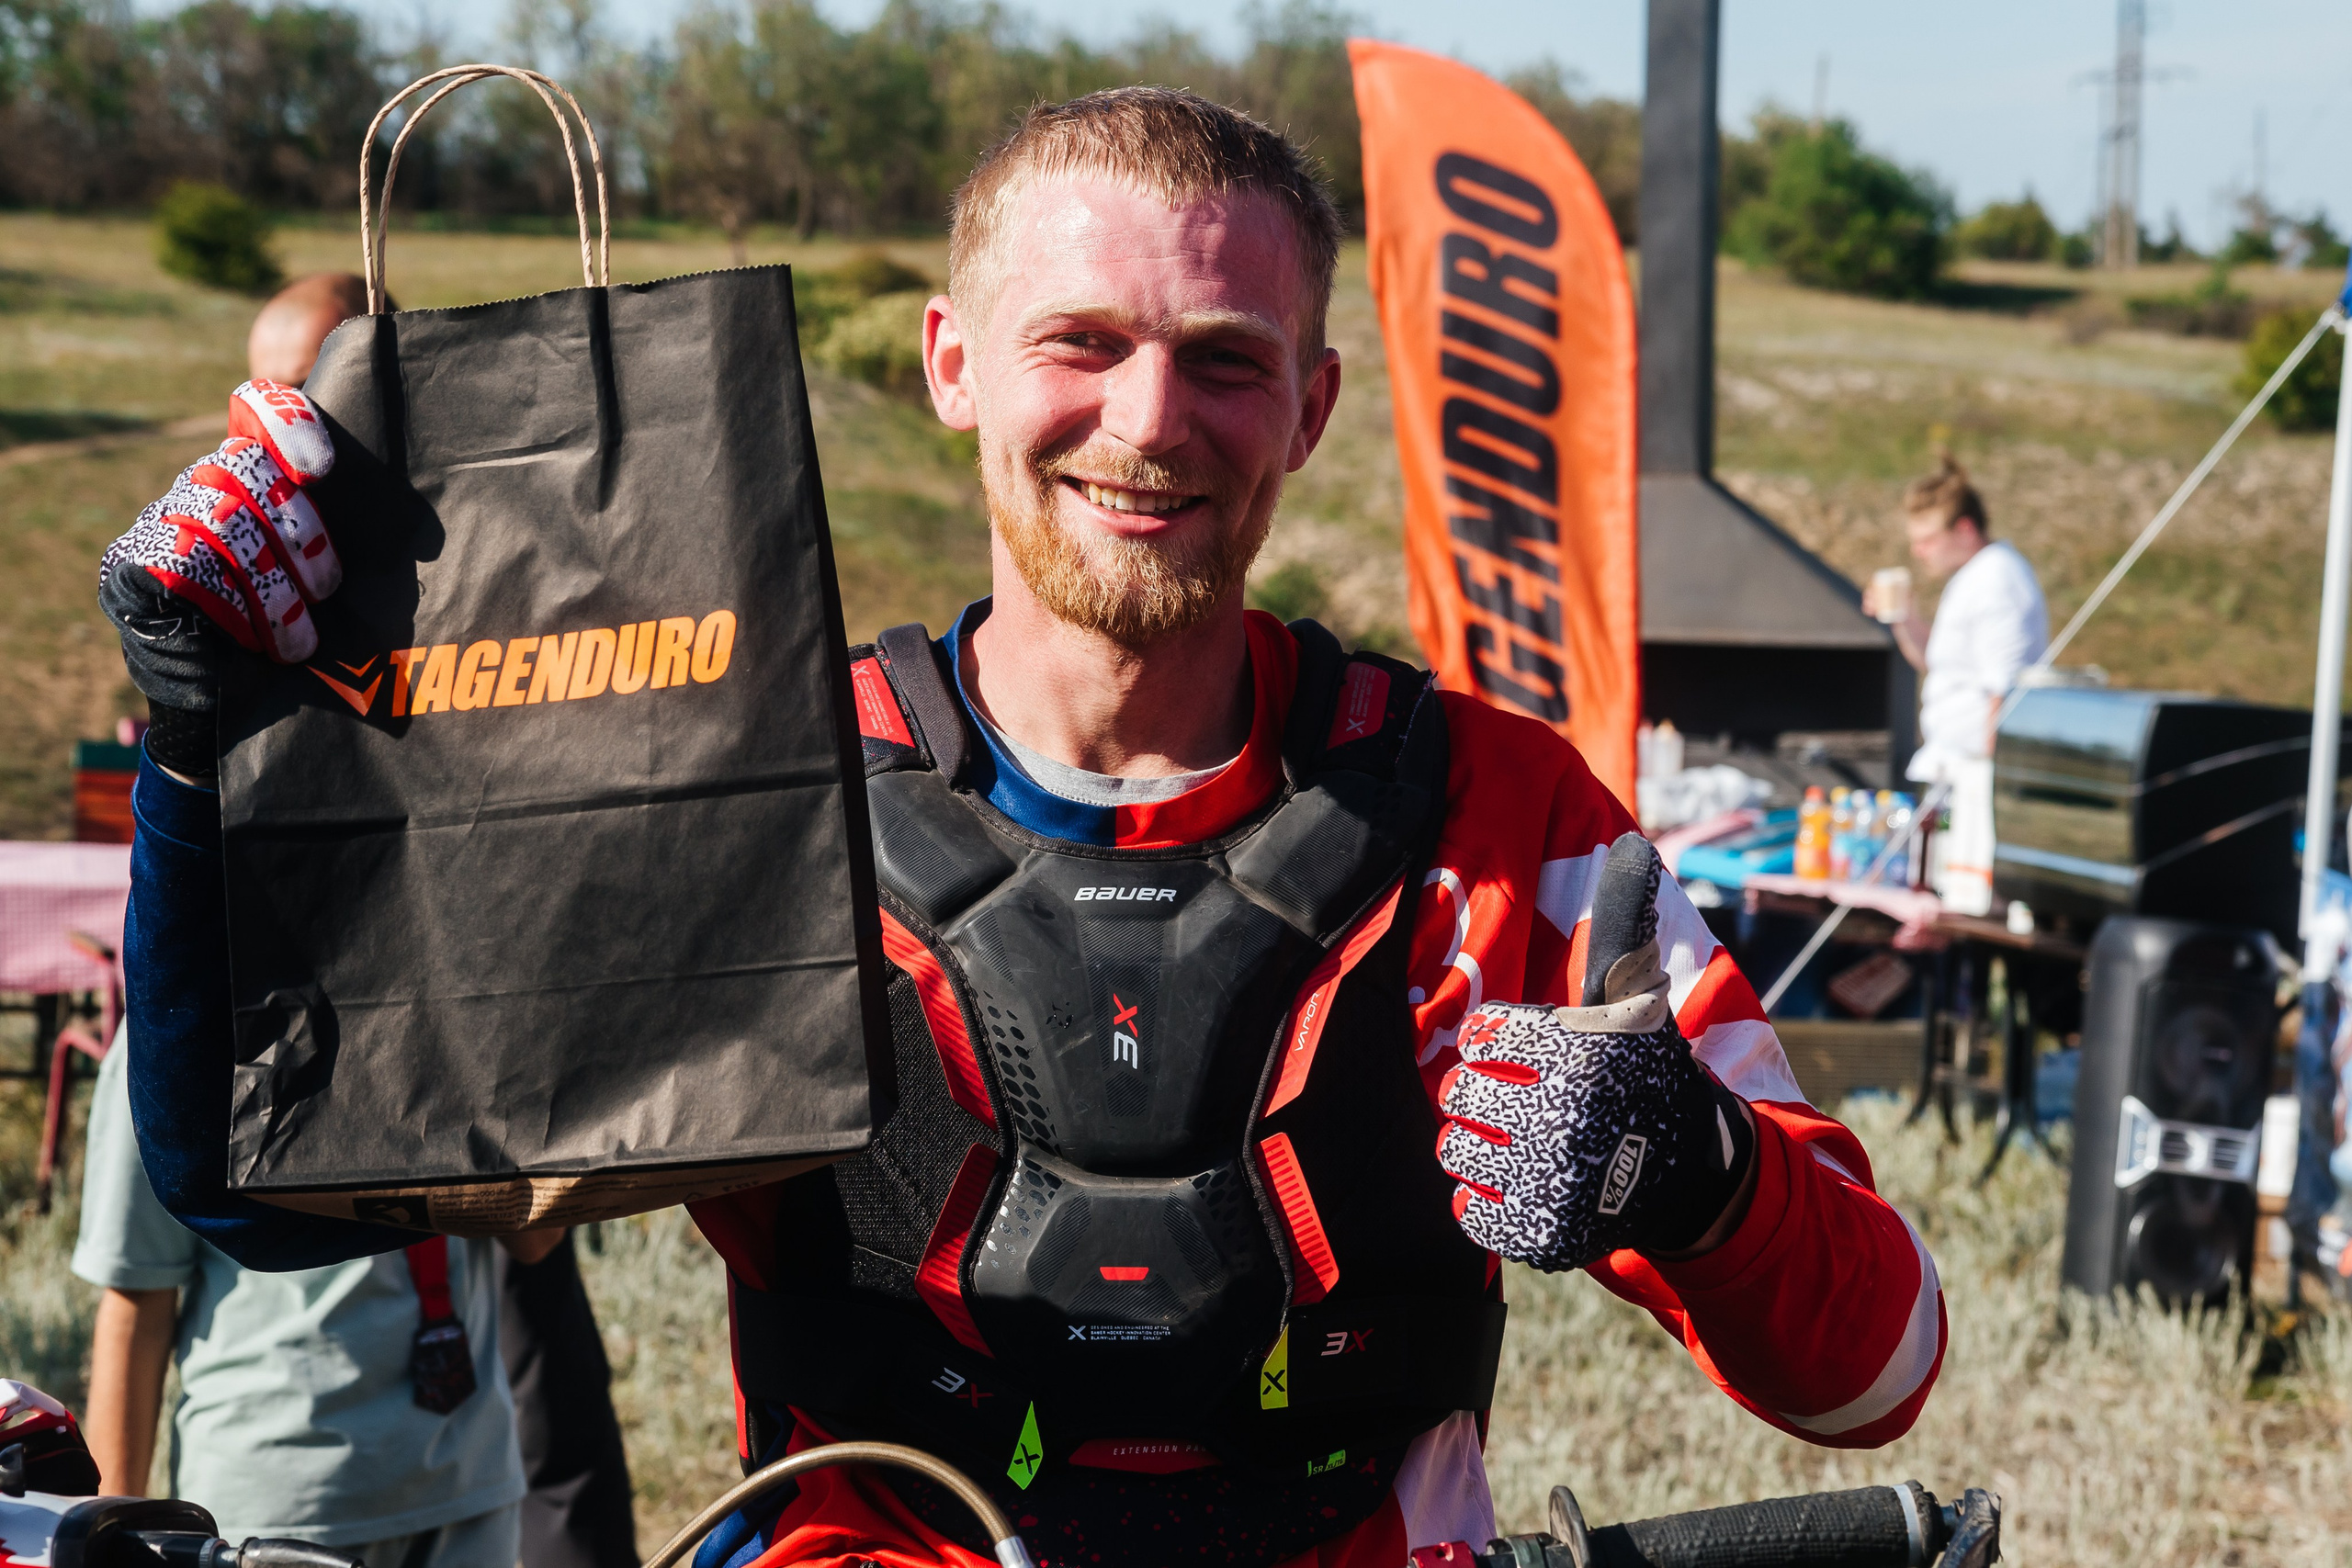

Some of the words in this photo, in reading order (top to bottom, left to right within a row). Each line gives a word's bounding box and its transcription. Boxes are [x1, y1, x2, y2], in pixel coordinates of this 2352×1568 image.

[1434, 150, 1571, 723] GENDURO
[389, 608, 737, 717] TAGENDURO
[1294, 992, 1323, 1052] VAPOR
[1604, 1144, 1638, 1205] 100%
[1321, 1328, 1374, 1357] 3X
[1113, 1445, 1178, 1456] EXTENSION
